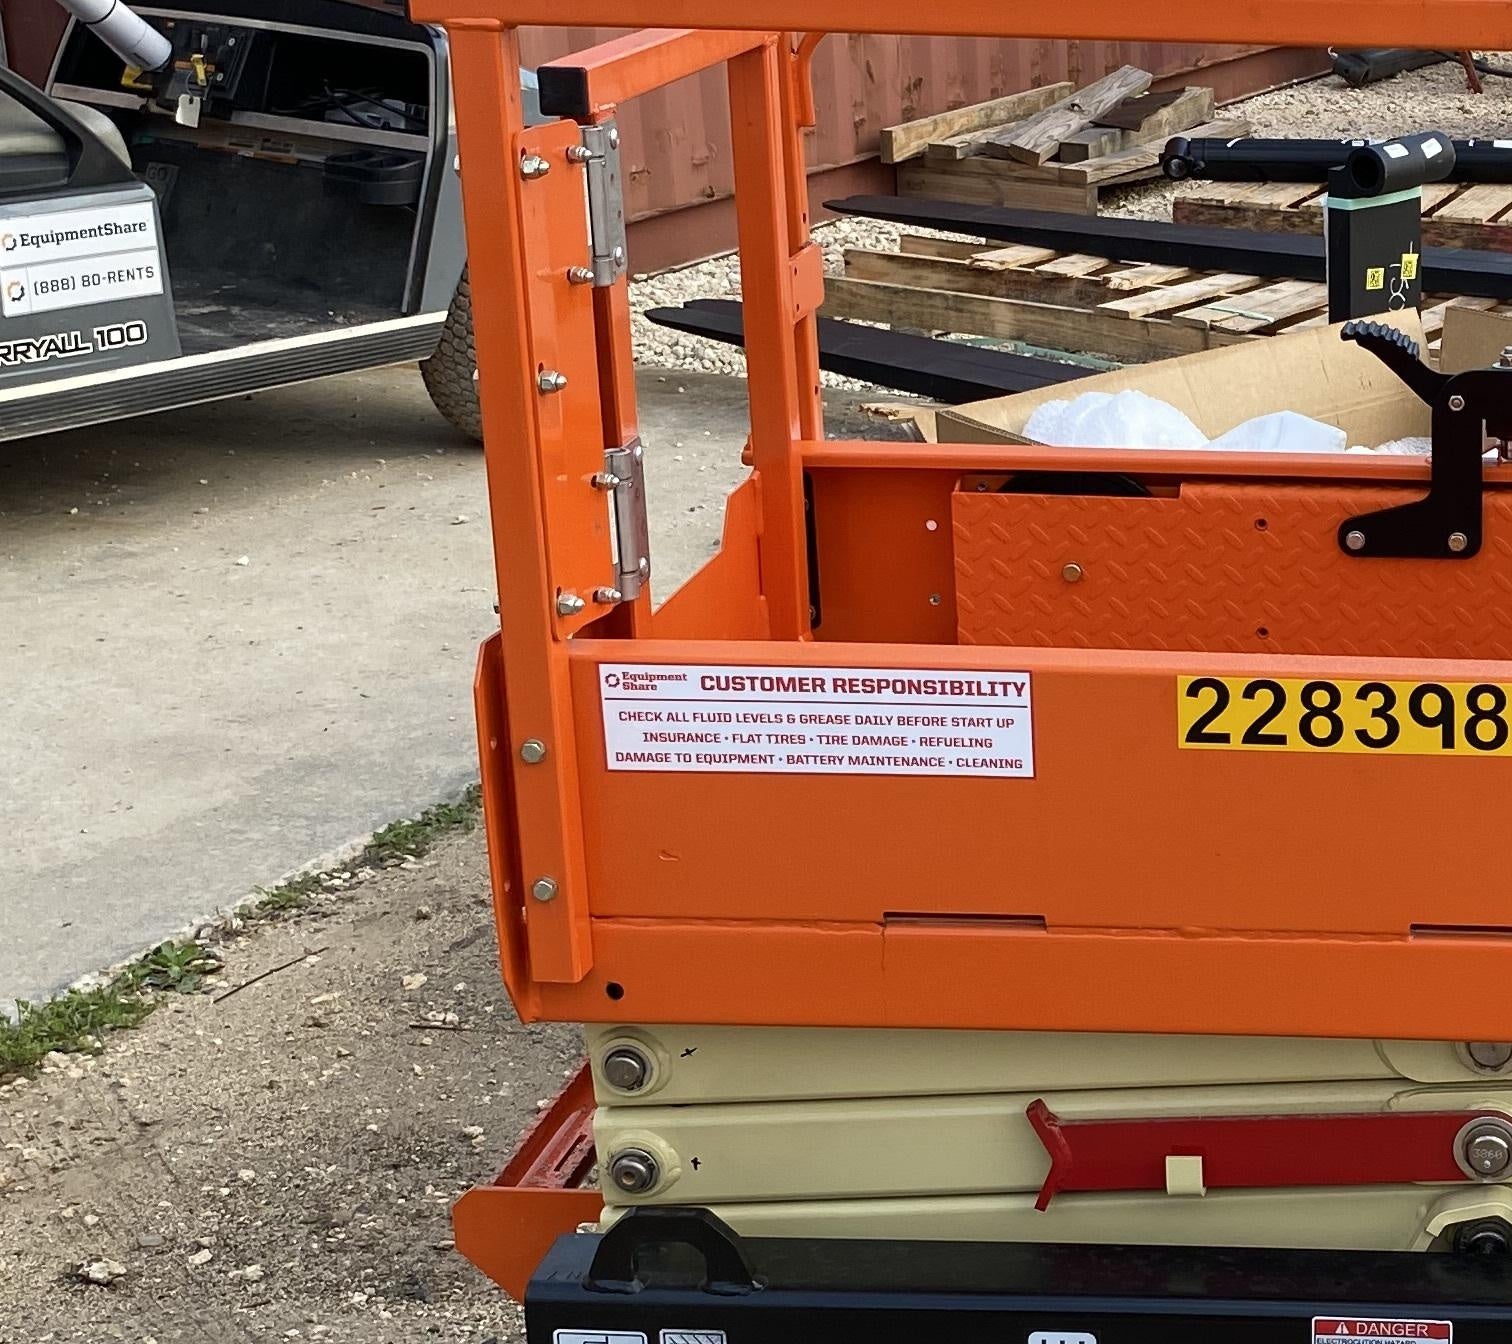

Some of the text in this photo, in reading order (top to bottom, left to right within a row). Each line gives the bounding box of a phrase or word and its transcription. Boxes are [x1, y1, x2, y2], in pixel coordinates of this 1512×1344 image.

[20, 221, 148, 248] EquipmentShare
[34, 266, 155, 296] (888) 80-RENTS
[96, 323, 146, 348] 100
[622, 671, 1027, 698] Equipment CUSTOMER RESPONSIBILITY
[622, 681, 658, 691] Share
[618, 711, 664, 723] CHECK
[666, 712, 690, 723] ALL
[692, 712, 732, 724] FLUID
[735, 712, 784, 725] LEVELS
[799, 714, 852, 726] GREASE
[854, 715, 894, 726] DAILY
[896, 716, 949, 728] BEFORE
[951, 717, 994, 729] START
[996, 718, 1015, 729] UP
[1185, 677, 1510, 752] 228398
[642, 731, 993, 749] INSURANCE FLAT TIRES TIRE DAMAGE REFUELING
[615, 751, 1024, 770] DAMAGE TO EQUIPMENT BATTERY MAINTENANCE CLEANING
[1356, 1322, 1429, 1337] DANGER
